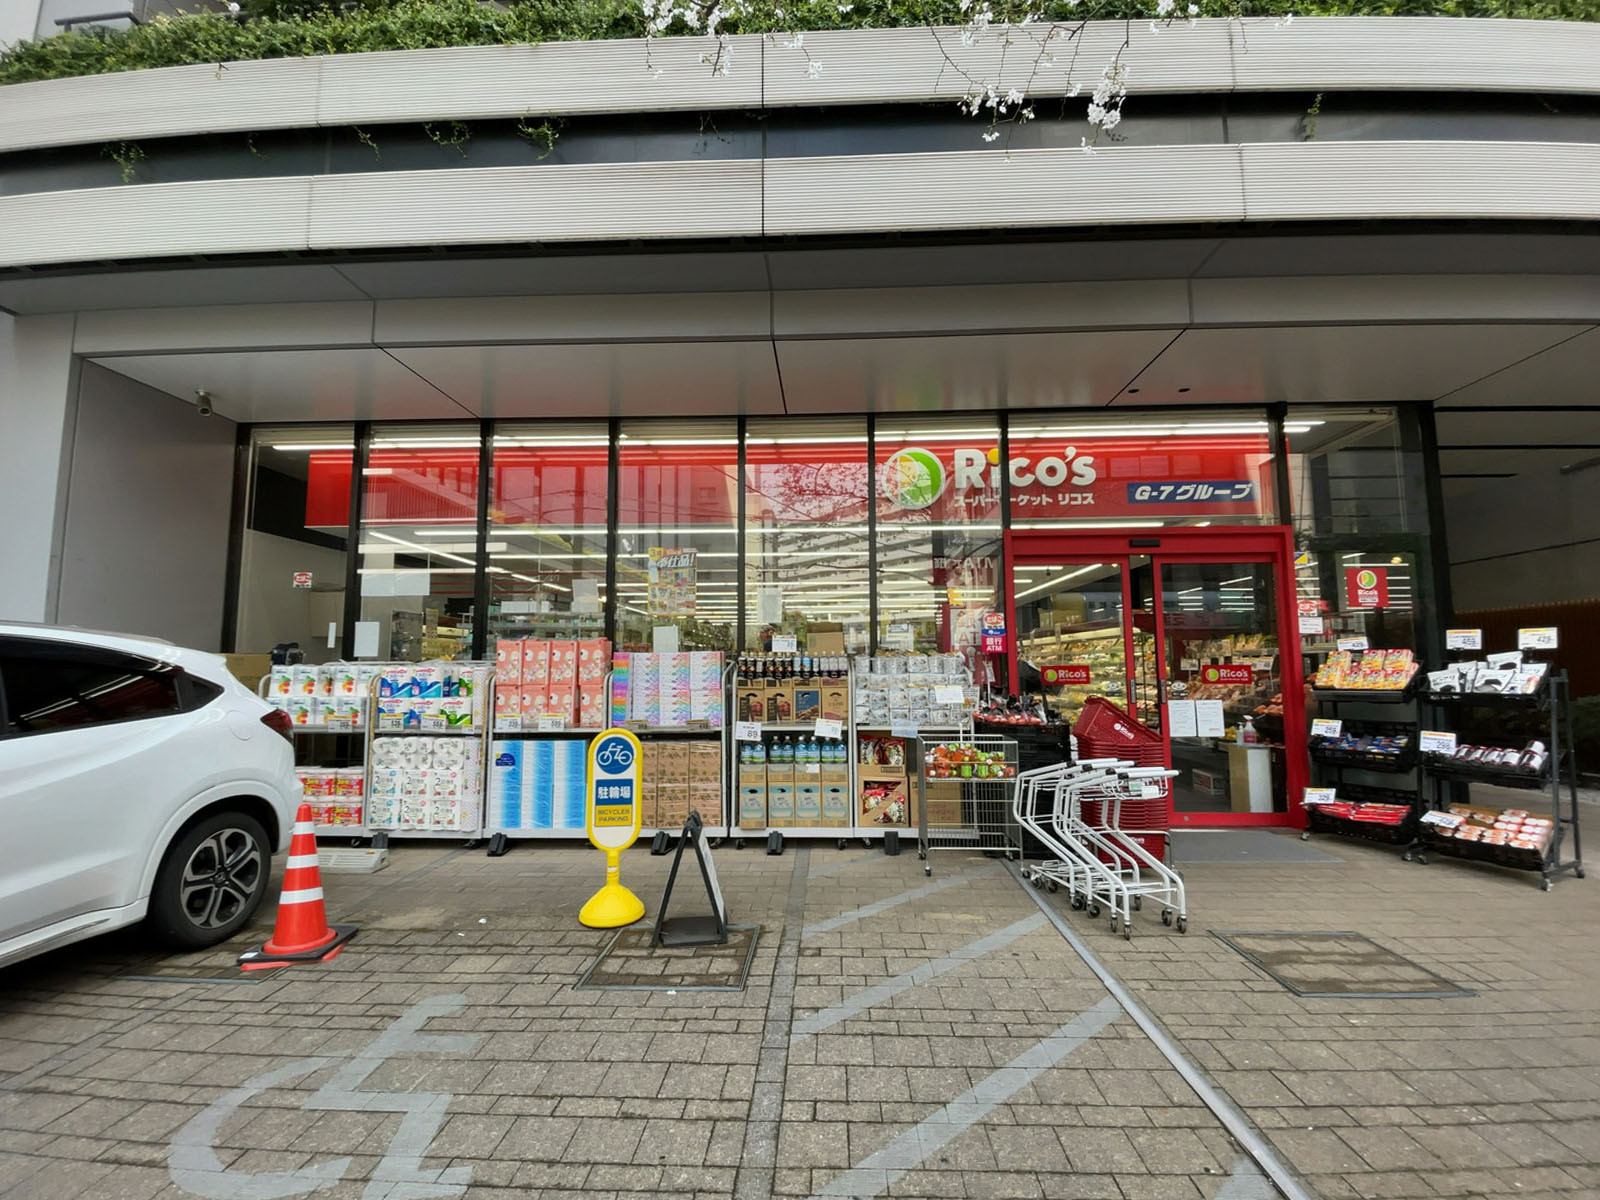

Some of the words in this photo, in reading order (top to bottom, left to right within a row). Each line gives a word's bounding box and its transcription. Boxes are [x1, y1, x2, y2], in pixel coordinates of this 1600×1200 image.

[954, 446, 1097, 489] Rico's
[1058, 492, 1095, 505] リコス
[1058, 669, 1087, 679] Rico's
[1219, 668, 1248, 678] Rico's
[597, 786, 631, 799] 駐輪場
